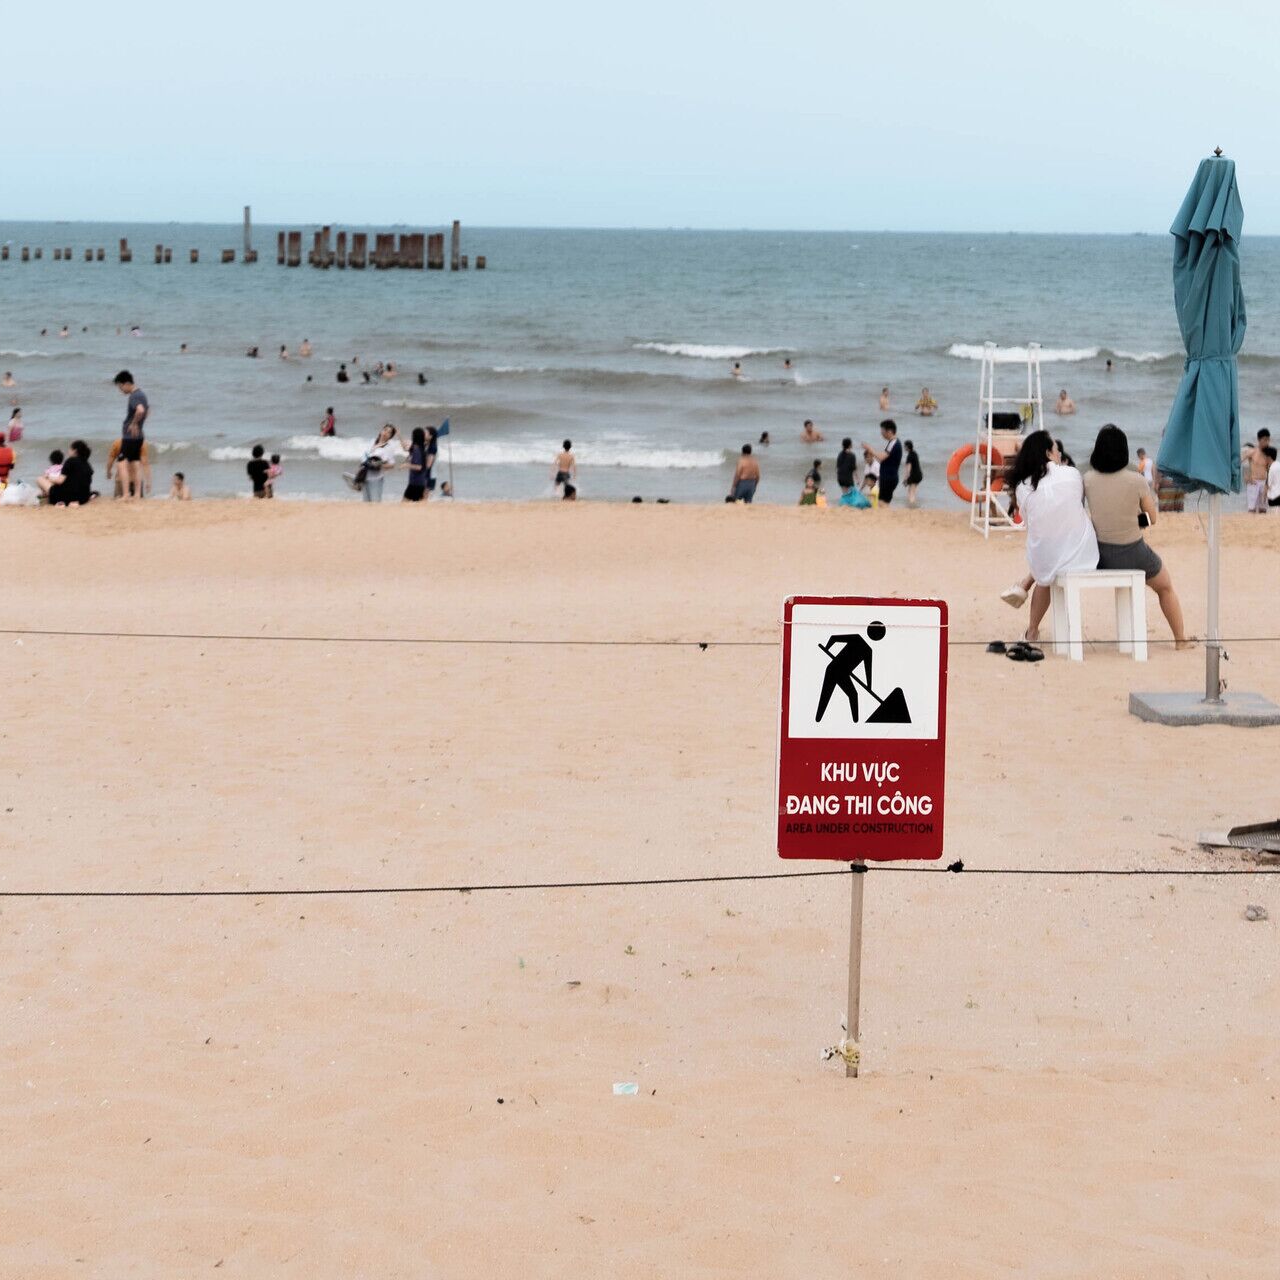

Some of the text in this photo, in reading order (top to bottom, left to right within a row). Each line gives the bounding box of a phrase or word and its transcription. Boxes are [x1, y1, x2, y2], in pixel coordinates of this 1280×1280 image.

[821, 761, 900, 787] KHU VỰC
[786, 791, 933, 815] ĐANG THI CÔNG
[785, 822, 933, 834] AREA UNDER CONSTRUCTION
